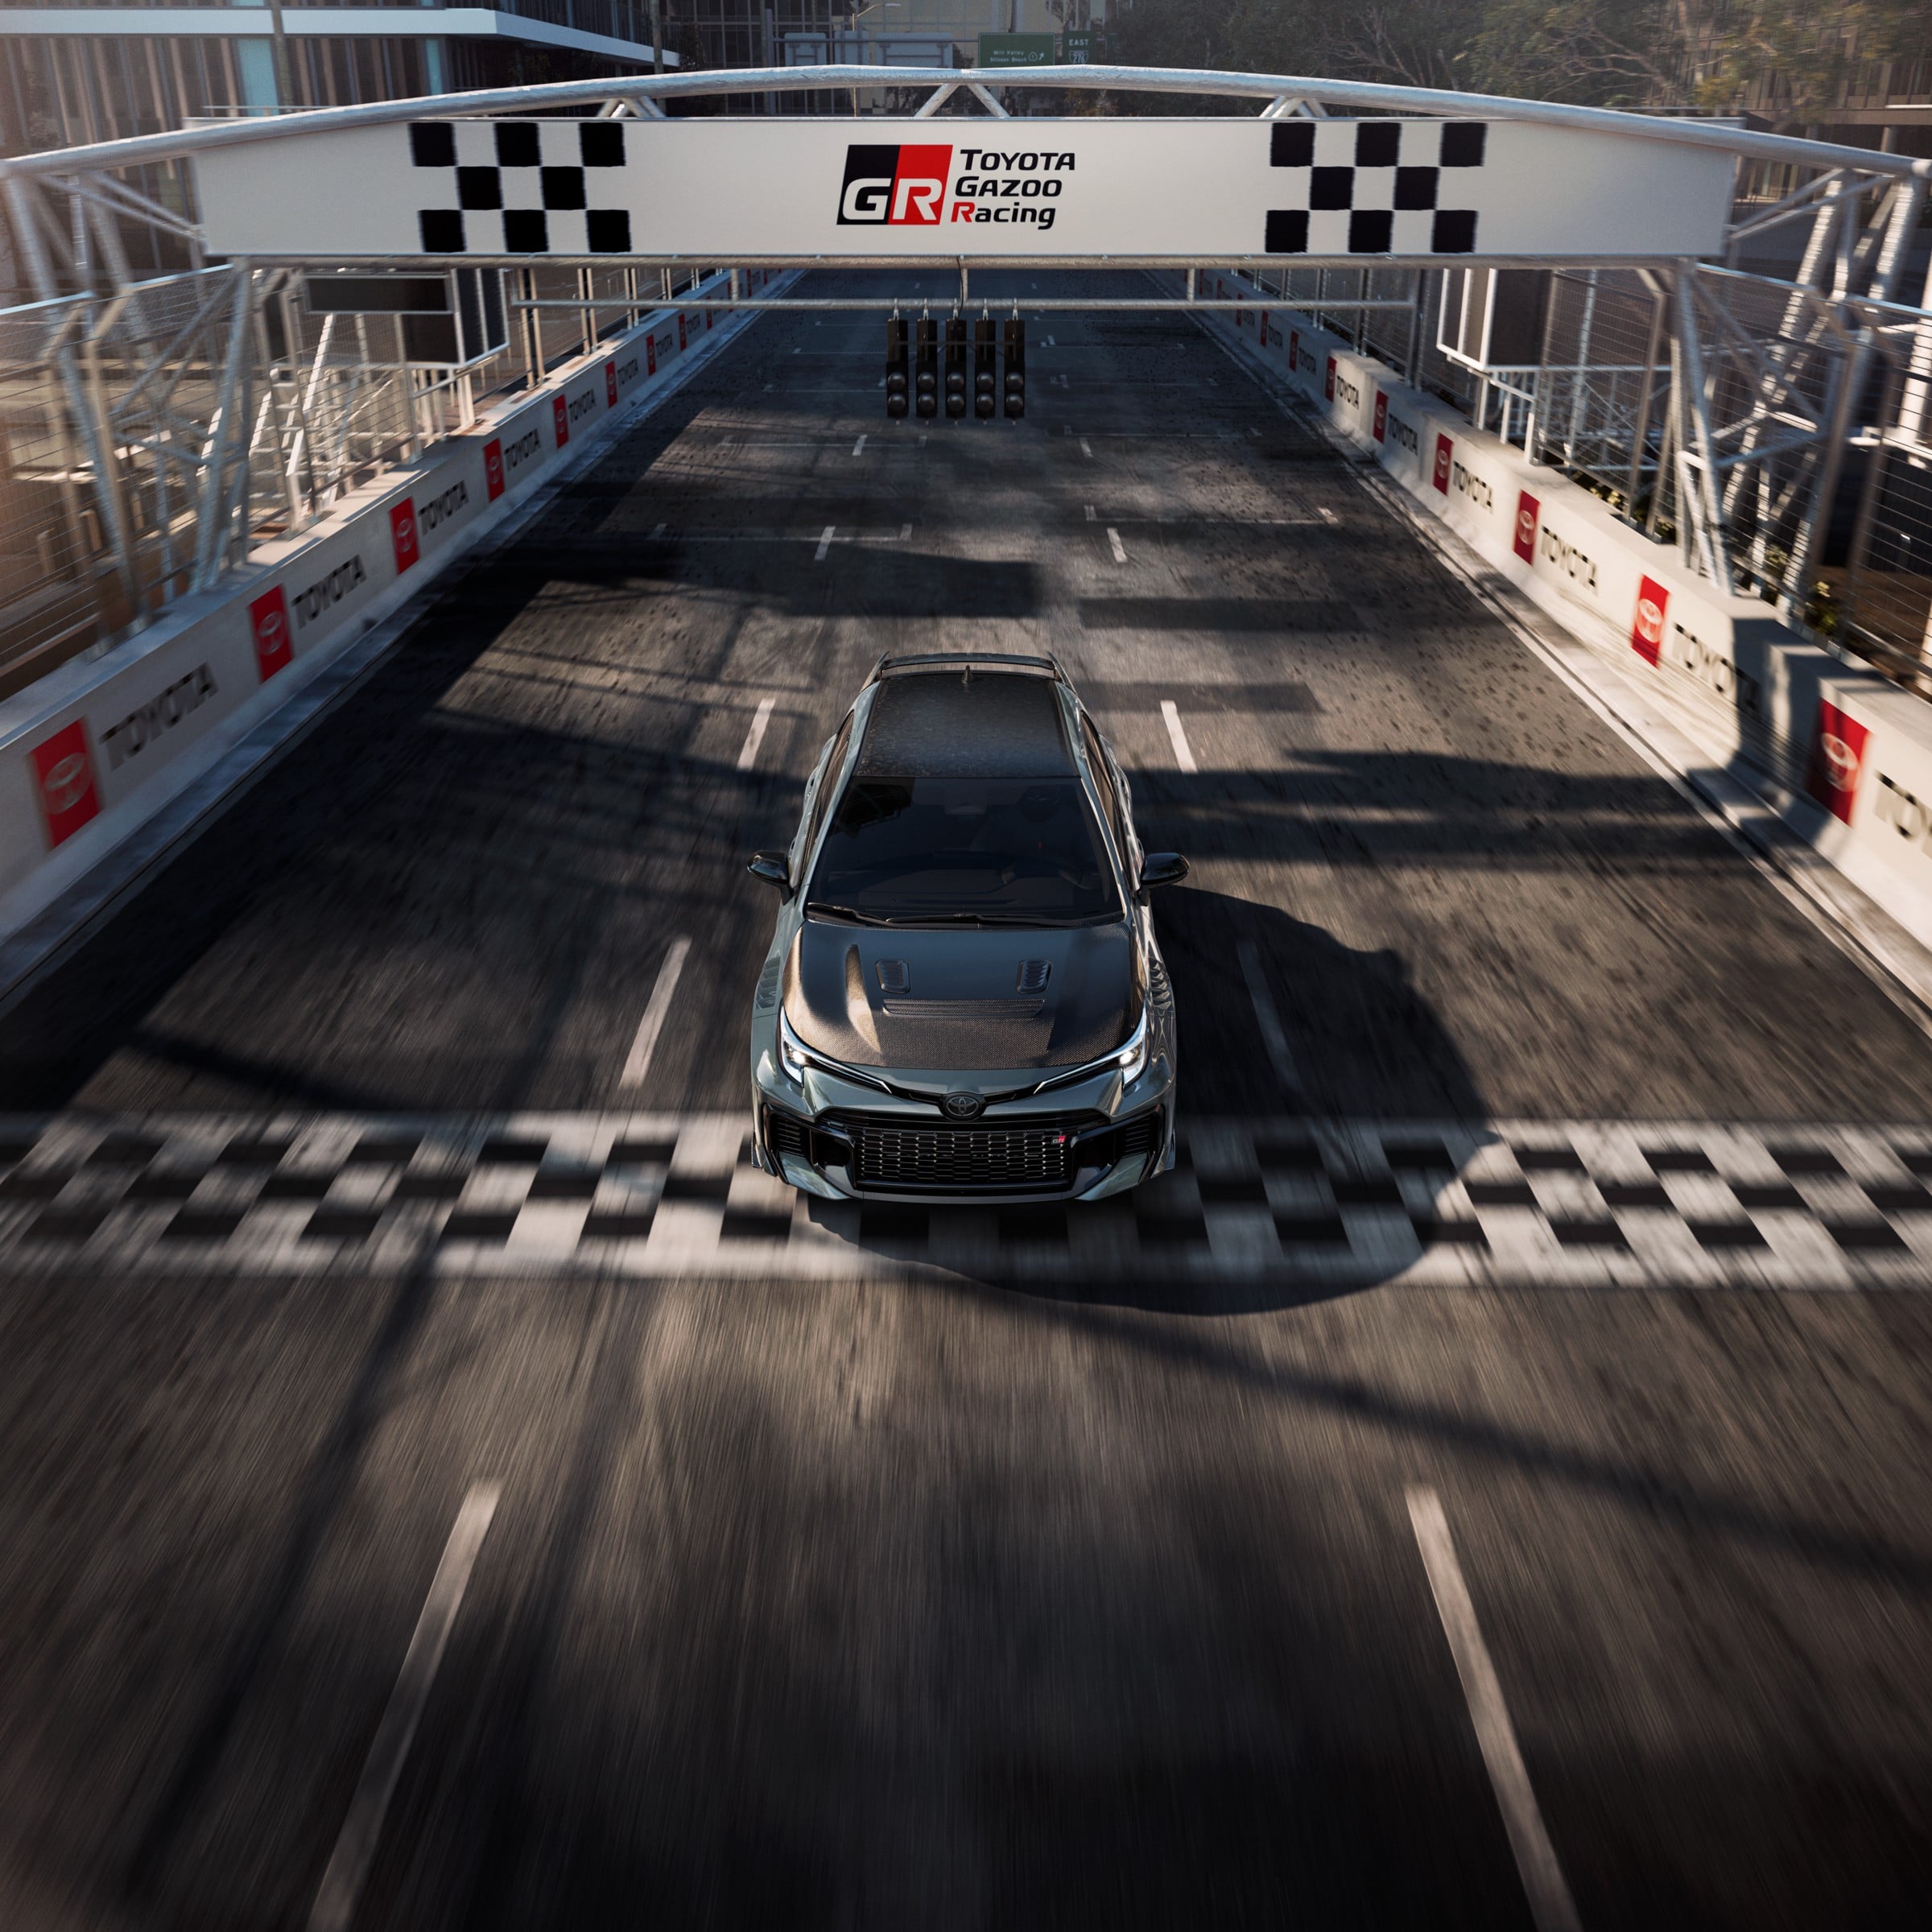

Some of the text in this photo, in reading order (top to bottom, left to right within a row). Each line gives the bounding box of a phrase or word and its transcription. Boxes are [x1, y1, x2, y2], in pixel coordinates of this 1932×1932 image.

[960, 149, 1075, 171] TOYOTA
[842, 178, 943, 221] GR
[956, 176, 1063, 197] GAZOO
[951, 201, 1056, 230] Racing
[617, 358, 638, 386] TOYOTA
[1336, 375, 1360, 410] TOYOTA
[568, 388, 597, 424] TOYOTA
[504, 428, 542, 472] TOYOTA
[1389, 413, 1418, 456] TOYOTA
[418, 481, 469, 535] TOYOTA
[1454, 461, 1493, 514] TOYOTA
[1541, 526, 1599, 597] TOYOTA
[291, 555, 367, 630] TOYOTA
[100, 663, 219, 770] TOYOTA
